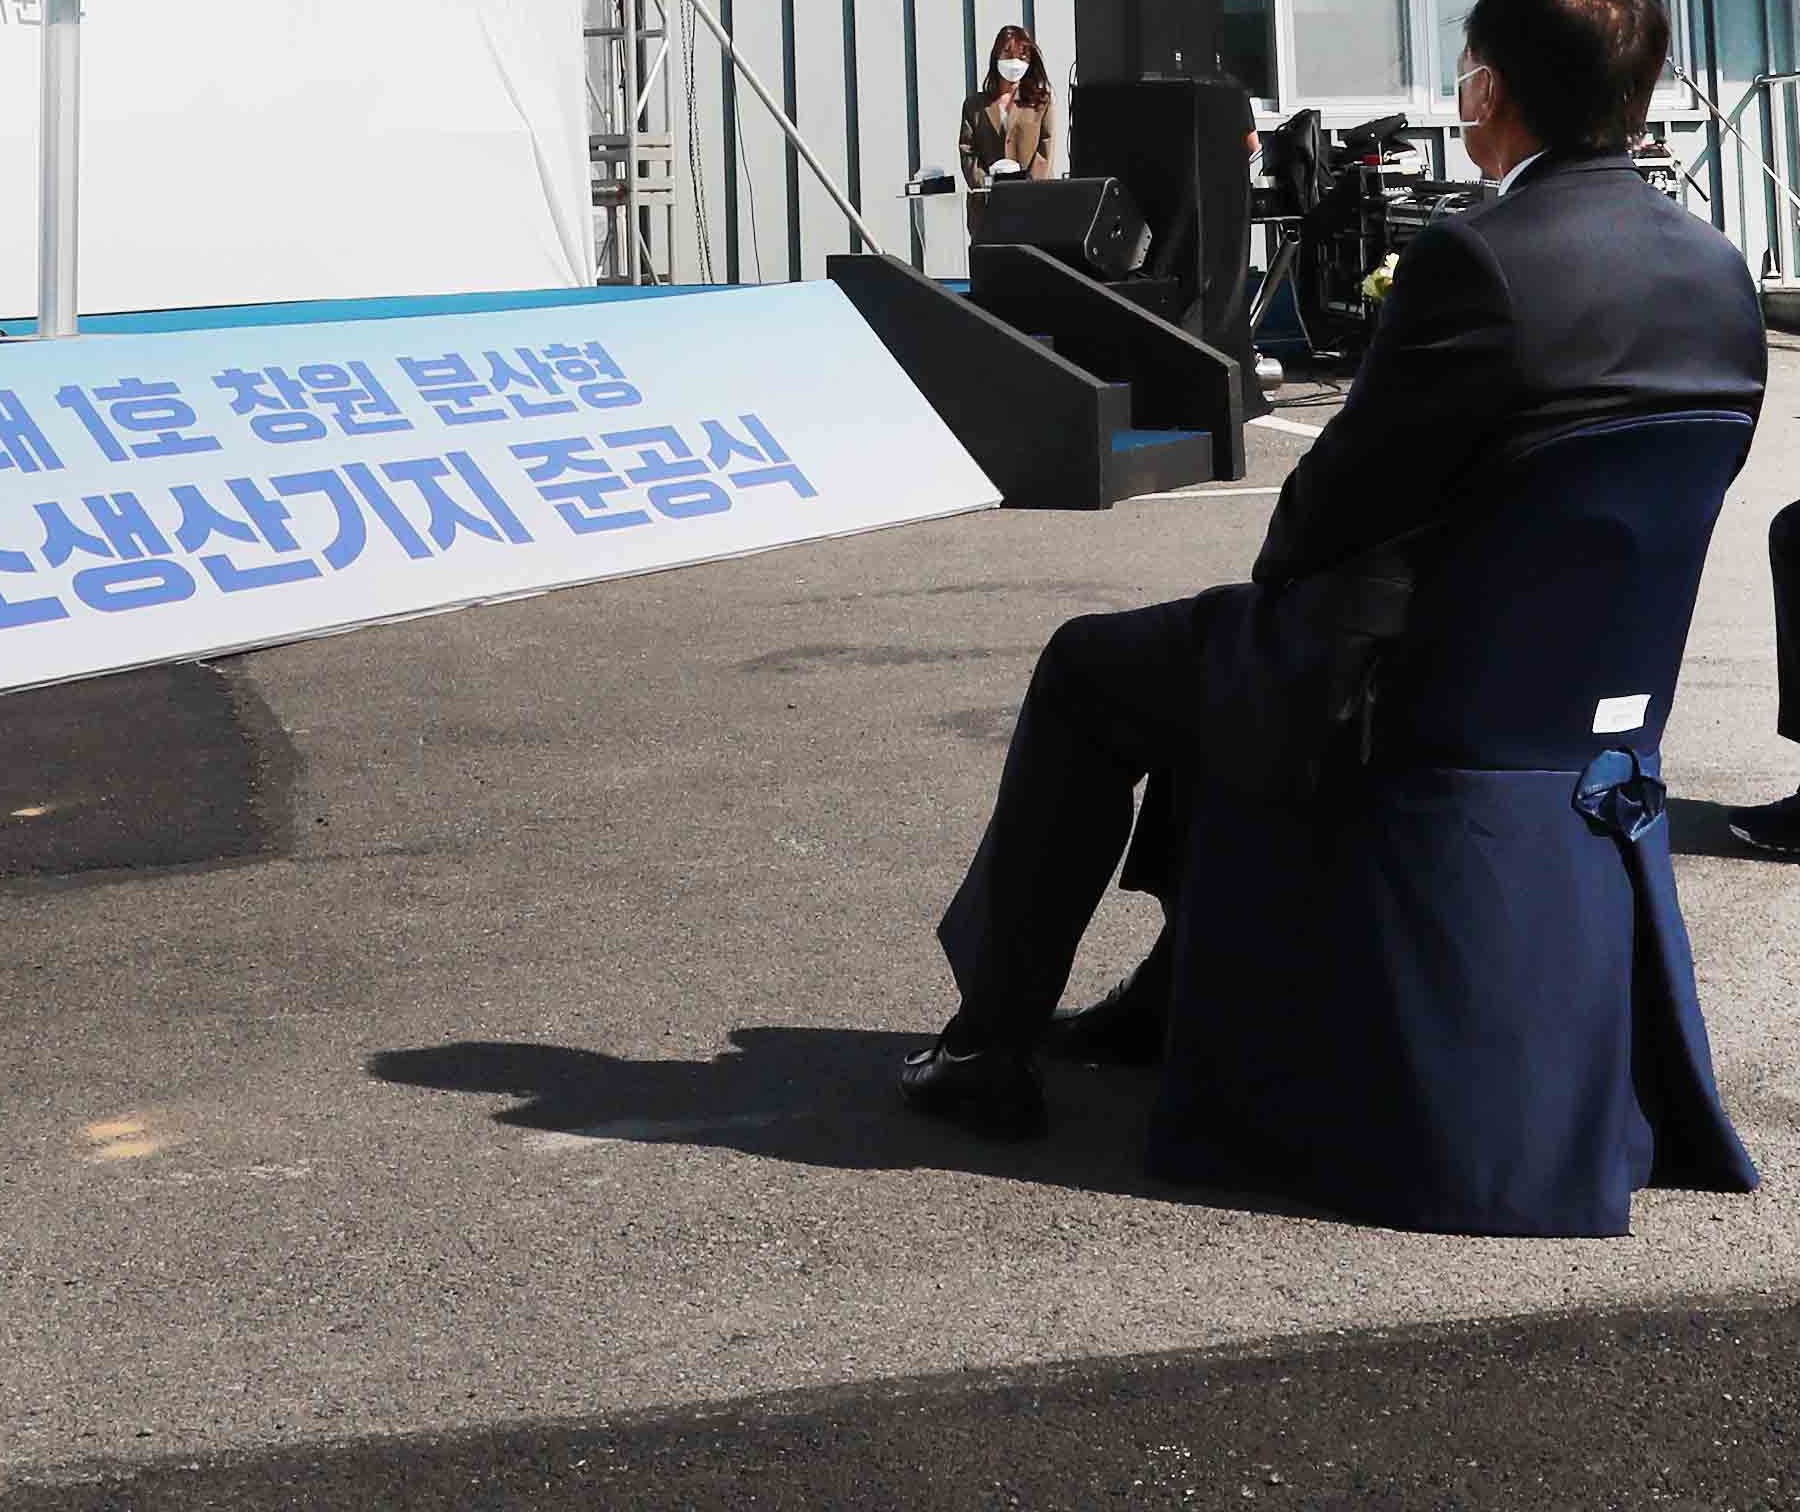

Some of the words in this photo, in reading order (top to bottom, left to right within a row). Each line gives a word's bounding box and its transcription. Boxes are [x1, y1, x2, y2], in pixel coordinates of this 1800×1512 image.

[54, 377, 222, 463] 1호
[212, 359, 415, 445] 창원
[399, 341, 643, 428] 분산형
[507, 413, 819, 536] 준공식
